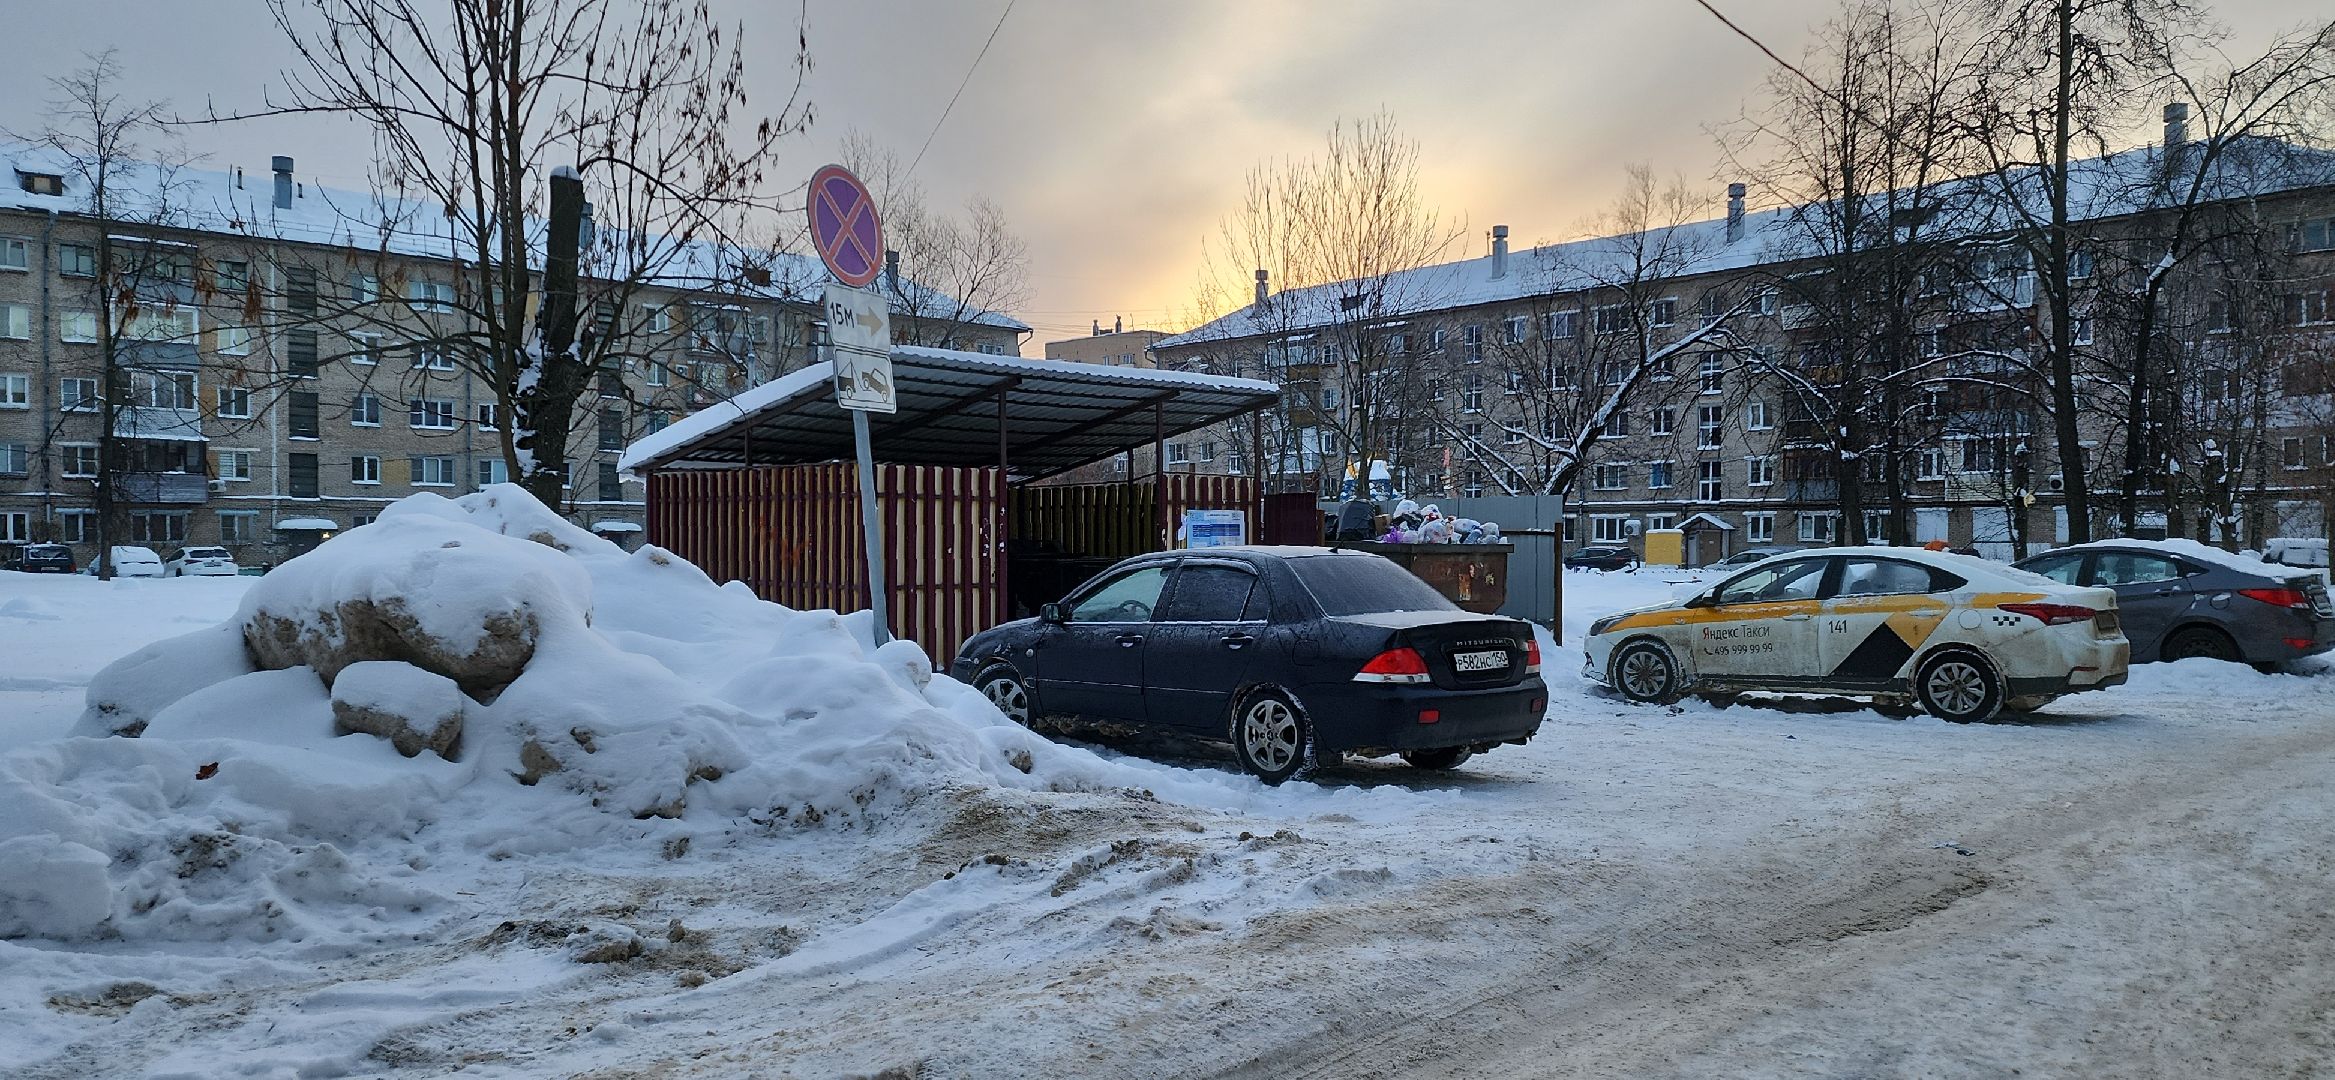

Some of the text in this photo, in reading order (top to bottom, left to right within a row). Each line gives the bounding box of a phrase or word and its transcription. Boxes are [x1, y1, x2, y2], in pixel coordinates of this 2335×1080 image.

[1703, 625, 1770, 640] Яндекс Такси
[1829, 620, 1847, 633] 141
[1715, 643, 1773, 655] 495 999 99 99
